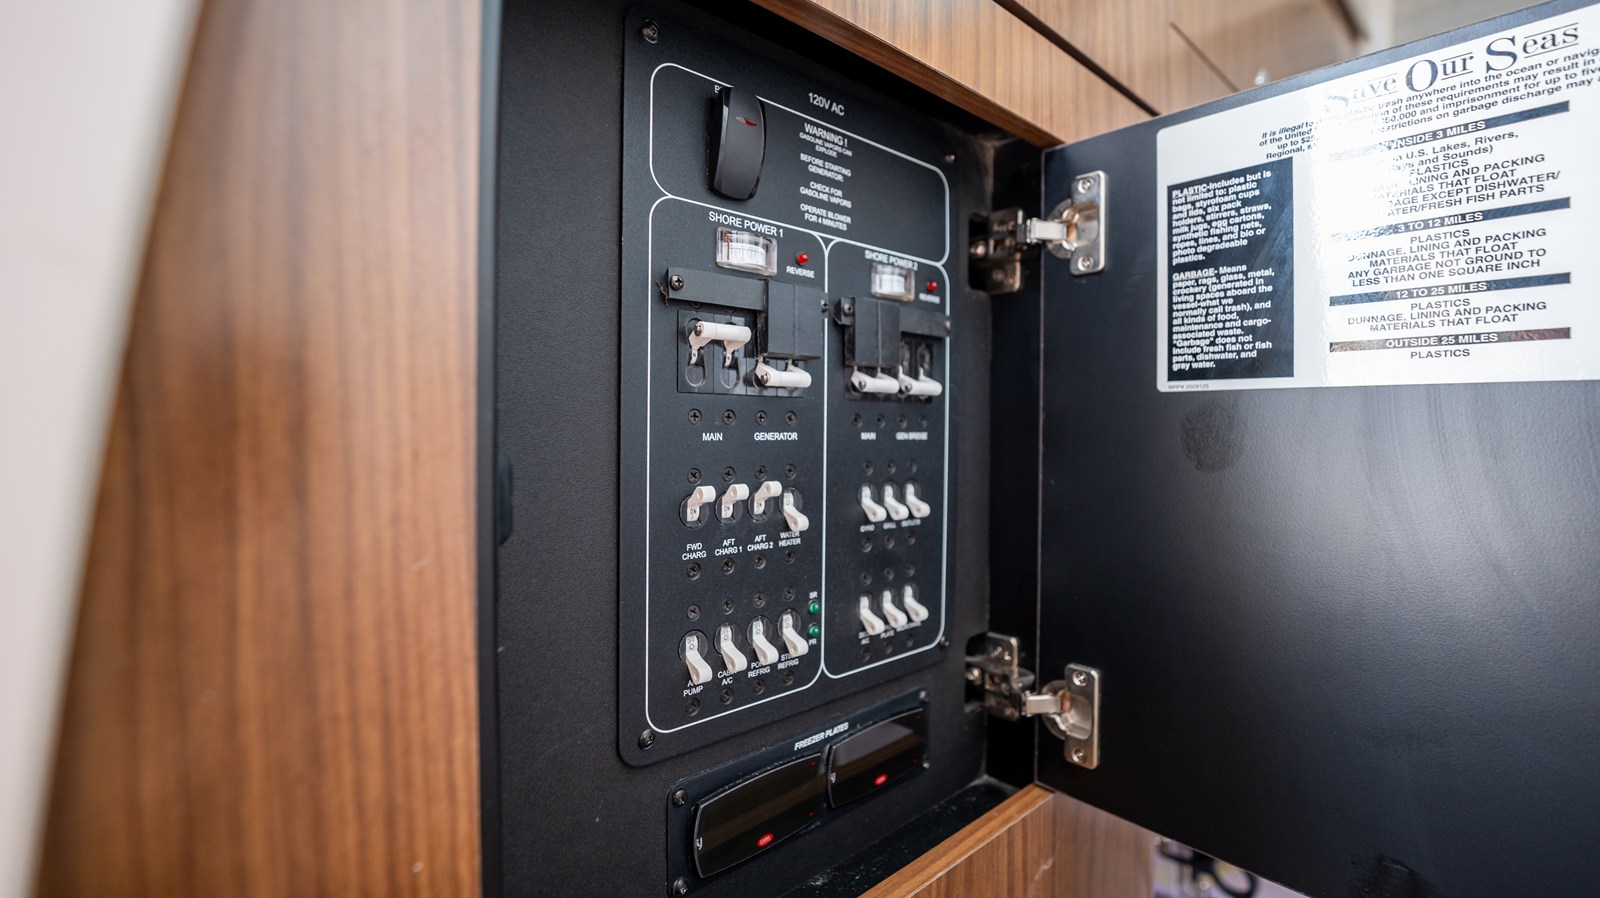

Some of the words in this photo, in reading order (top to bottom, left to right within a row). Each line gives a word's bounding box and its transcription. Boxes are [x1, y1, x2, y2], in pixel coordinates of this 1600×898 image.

[1405, 56, 1474, 92] Our
[1486, 27, 1579, 74] Seas
[1269, 136, 1283, 145] the
[1284, 128, 1313, 140] United
[1405, 99, 1433, 111] these
[1436, 78, 1510, 102] requirements
[1513, 73, 1539, 85] may
[1543, 61, 1578, 76] result
[1583, 58, 1595, 67] in
[1279, 121, 1304, 135] illegal
[1406, 84, 1456, 102] anywhere
[1459, 78, 1481, 89] into
[1484, 73, 1502, 83] the
[1506, 63, 1542, 76] ocean
[1419, 105, 1439, 116] and
[1442, 86, 1521, 110] imprisonment
[1524, 80, 1541, 90] for
[1545, 76, 1561, 85] up
[1565, 72, 1577, 80] to
[808, 92, 830, 110] 120V
[830, 101, 845, 116] AC
[1265, 145, 1305, 160] Regional,
[1436, 110, 1449, 119] on
[1453, 100, 1498, 117] garbage
[1502, 85, 1562, 105] discharge
[1566, 77, 1593, 90] may
[804, 122, 843, 146] WARNING
[1446, 120, 1487, 137] MILES
[1406, 148, 1429, 159] U.S.
[1432, 140, 1471, 154] Lakes,
[1475, 131, 1519, 145] Rivers,
[800, 153, 824, 167] BEFORE
[1418, 155, 1439, 166] and
[1442, 144, 1494, 162] Sounds)
[1453, 166, 1480, 178] AND
[1484, 153, 1545, 172] PACKING
[1246, 172, 1261, 182] but
[1263, 170, 1272, 178] is
[1422, 186, 1471, 200] EXCEPT
[1475, 170, 1561, 193] DISHWATER/
[1438, 177, 1470, 190] THAT
[1474, 168, 1517, 184] FLOAT
[800, 186, 829, 201] GASOLINE
[810, 181, 830, 194] CHECK
[830, 187, 843, 197] FOR
[1172, 197, 1185, 206] not
[1187, 189, 1214, 202] limited
[1228, 181, 1257, 194] plastic
[1466, 191, 1495, 204] FISH
[1499, 183, 1545, 199] PARTS
[800, 203, 827, 217] OPERATE
[1172, 203, 1194, 213] bags,
[1195, 193, 1236, 209] styrofoam
[1238, 189, 1260, 200] cups
[1172, 211, 1187, 220] and
[1207, 203, 1220, 212] six
[1221, 200, 1242, 211] pack
[804, 212, 818, 222] FOR
[1172, 216, 1204, 228] holders,
[1205, 209, 1238, 221] stirrers,
[1240, 202, 1272, 215] straws,
[1172, 225, 1189, 235] milk
[1229, 212, 1265, 225] cartons,
[1407, 221, 1424, 231] TO
[1427, 219, 1441, 228] 12
[1444, 212, 1484, 226] MILES
[708, 211, 742, 228] SHORE
[744, 219, 777, 237] POWER
[779, 228, 784, 238] 1
[1172, 229, 1209, 243] synthetic
[1210, 223, 1239, 236] fishing
[1240, 220, 1262, 230] nets,
[1172, 240, 1197, 250] ropes,
[1198, 236, 1221, 246] lines,
[1222, 232, 1238, 241] and
[1409, 241, 1450, 254] LINING
[1453, 237, 1481, 248] AND
[1485, 228, 1547, 244] PACKING
[1410, 228, 1470, 244] PLASTICS
[864, 249, 889, 264] SHORE
[1172, 247, 1196, 258] photo
[1197, 238, 1248, 253] degradeable
[1369, 252, 1436, 268] MATERIALS
[1439, 247, 1471, 259] THAT
[1475, 241, 1518, 255] FLOAT
[1172, 254, 1206, 266] plastics.
[1347, 269, 1370, 279] ANY
[1373, 261, 1431, 276] GARBAGE
[1435, 258, 1461, 268] NOT
[1465, 251, 1523, 266] GROUND
[1527, 248, 1546, 258] TO
[786, 265, 815, 279] REVERSE
[1219, 264, 1247, 275] Means
[1352, 276, 1381, 287] LESS
[1383, 273, 1415, 284] THAN
[1418, 269, 1444, 280] ONE
[1448, 263, 1503, 277] SQUARE
[1507, 259, 1540, 270] INCH
[1172, 284, 1207, 295] crockery
[1208, 277, 1254, 293] (generated
[1172, 294, 1194, 303] living
[1196, 290, 1225, 301] spaces
[1226, 286, 1257, 297] aboard
[1258, 284, 1273, 293] the
[1395, 290, 1408, 299] 12
[1411, 288, 1428, 297] TO
[1430, 286, 1445, 296] 25
[1448, 282, 1488, 294] MILES
[1347, 313, 1406, 325] DUNNAGE,
[1410, 309, 1450, 320] LINING
[1454, 307, 1481, 317] AND
[1485, 301, 1547, 314] PACKING
[1410, 298, 1471, 311] PLASTICS
[1172, 321, 1224, 333] maintenance
[1225, 319, 1241, 328] and
[1242, 318, 1272, 329] cargo-
[1370, 320, 1436, 332] MATERIALS
[1439, 317, 1471, 327] THAT
[1475, 313, 1519, 325] FLOAT
[1385, 337, 1438, 348] OUTSIDE
[1440, 336, 1455, 344] 25
[1458, 333, 1498, 344] MILES
[1196, 351, 1239, 362] dishwater,
[1240, 349, 1257, 359] and
[1410, 348, 1470, 359] PLASTICS
[1172, 362, 1190, 372] gray
[1192, 360, 1216, 369] water.
[702, 432, 723, 441] MAIN
[753, 432, 798, 441] GENERATOR
[686, 542, 703, 551] FWD
[722, 538, 735, 547] AFT
[747, 542, 768, 552] CHARG
[768, 541, 774, 549] 2
[754, 534, 767, 543] AFT
[778, 538, 802, 548] HEATER
[682, 550, 707, 561] CHARG
[715, 546, 738, 557] CHARG
[748, 666, 771, 679] REFRIG
[778, 658, 799, 670] REFRIG
[683, 685, 704, 697] PUMP
[794, 731, 825, 751] FREEZER
[825, 721, 849, 738] PLATES
